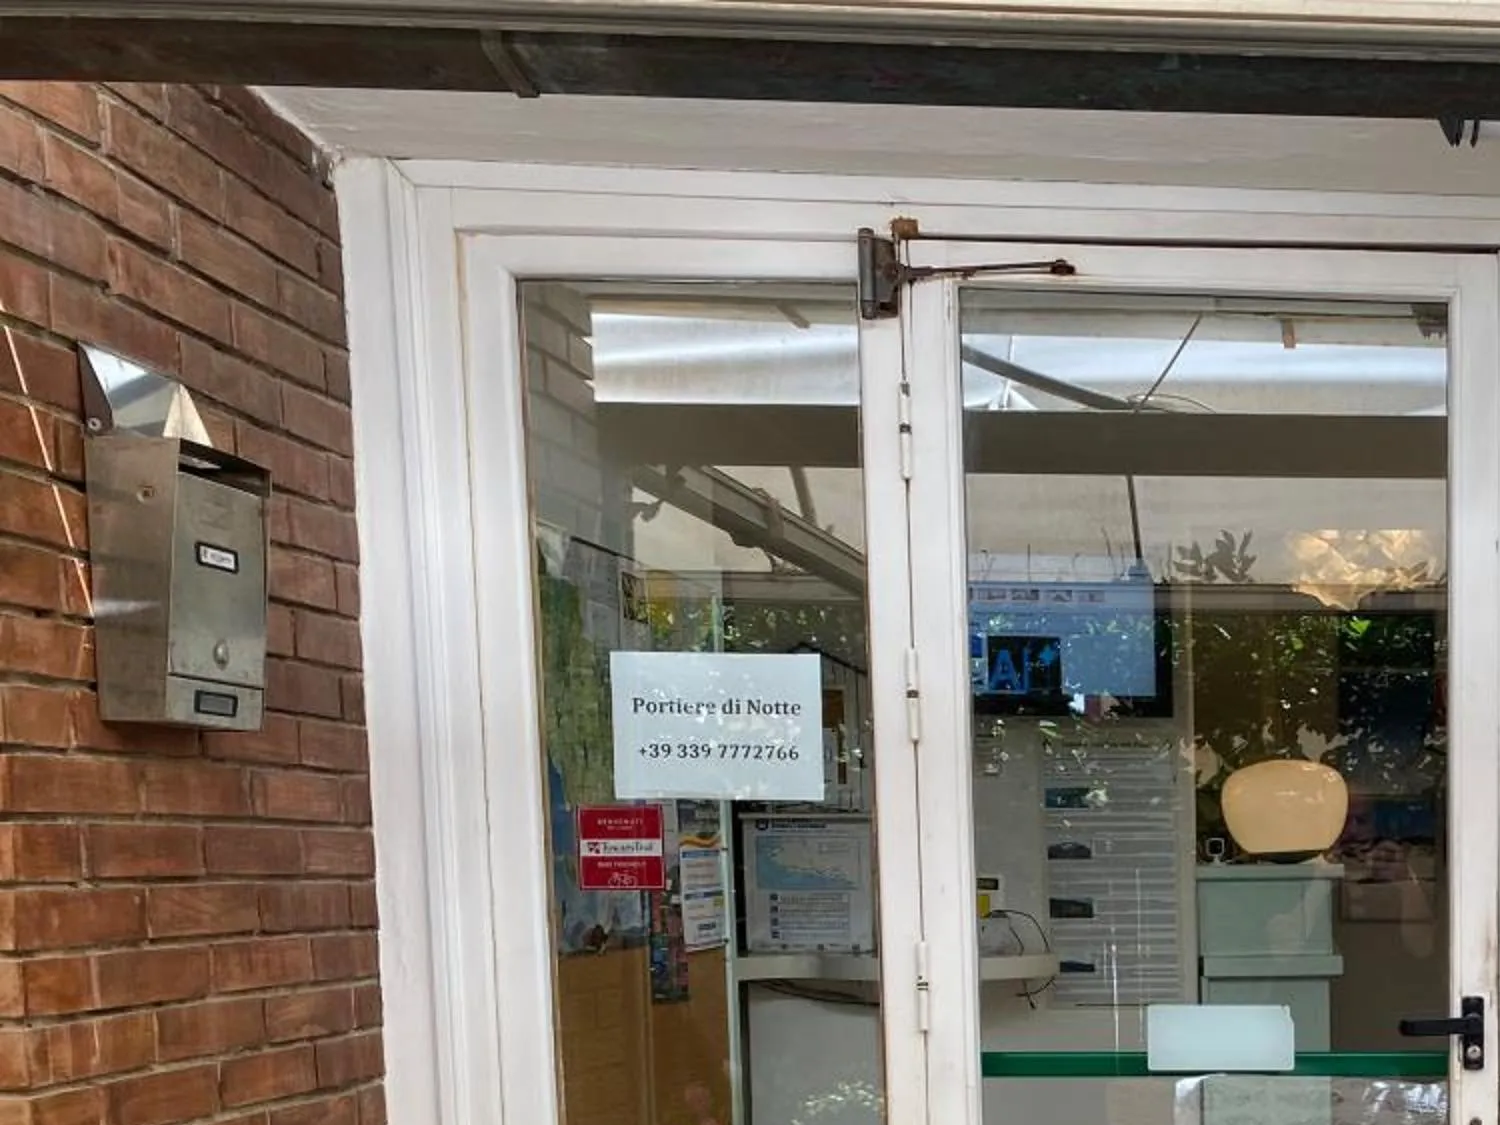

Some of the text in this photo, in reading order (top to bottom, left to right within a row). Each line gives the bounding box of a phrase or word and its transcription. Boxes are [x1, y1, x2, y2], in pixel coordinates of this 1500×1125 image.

[632, 697, 801, 716] Portiere di Notte
[639, 743, 799, 760] +39 339 7772766
